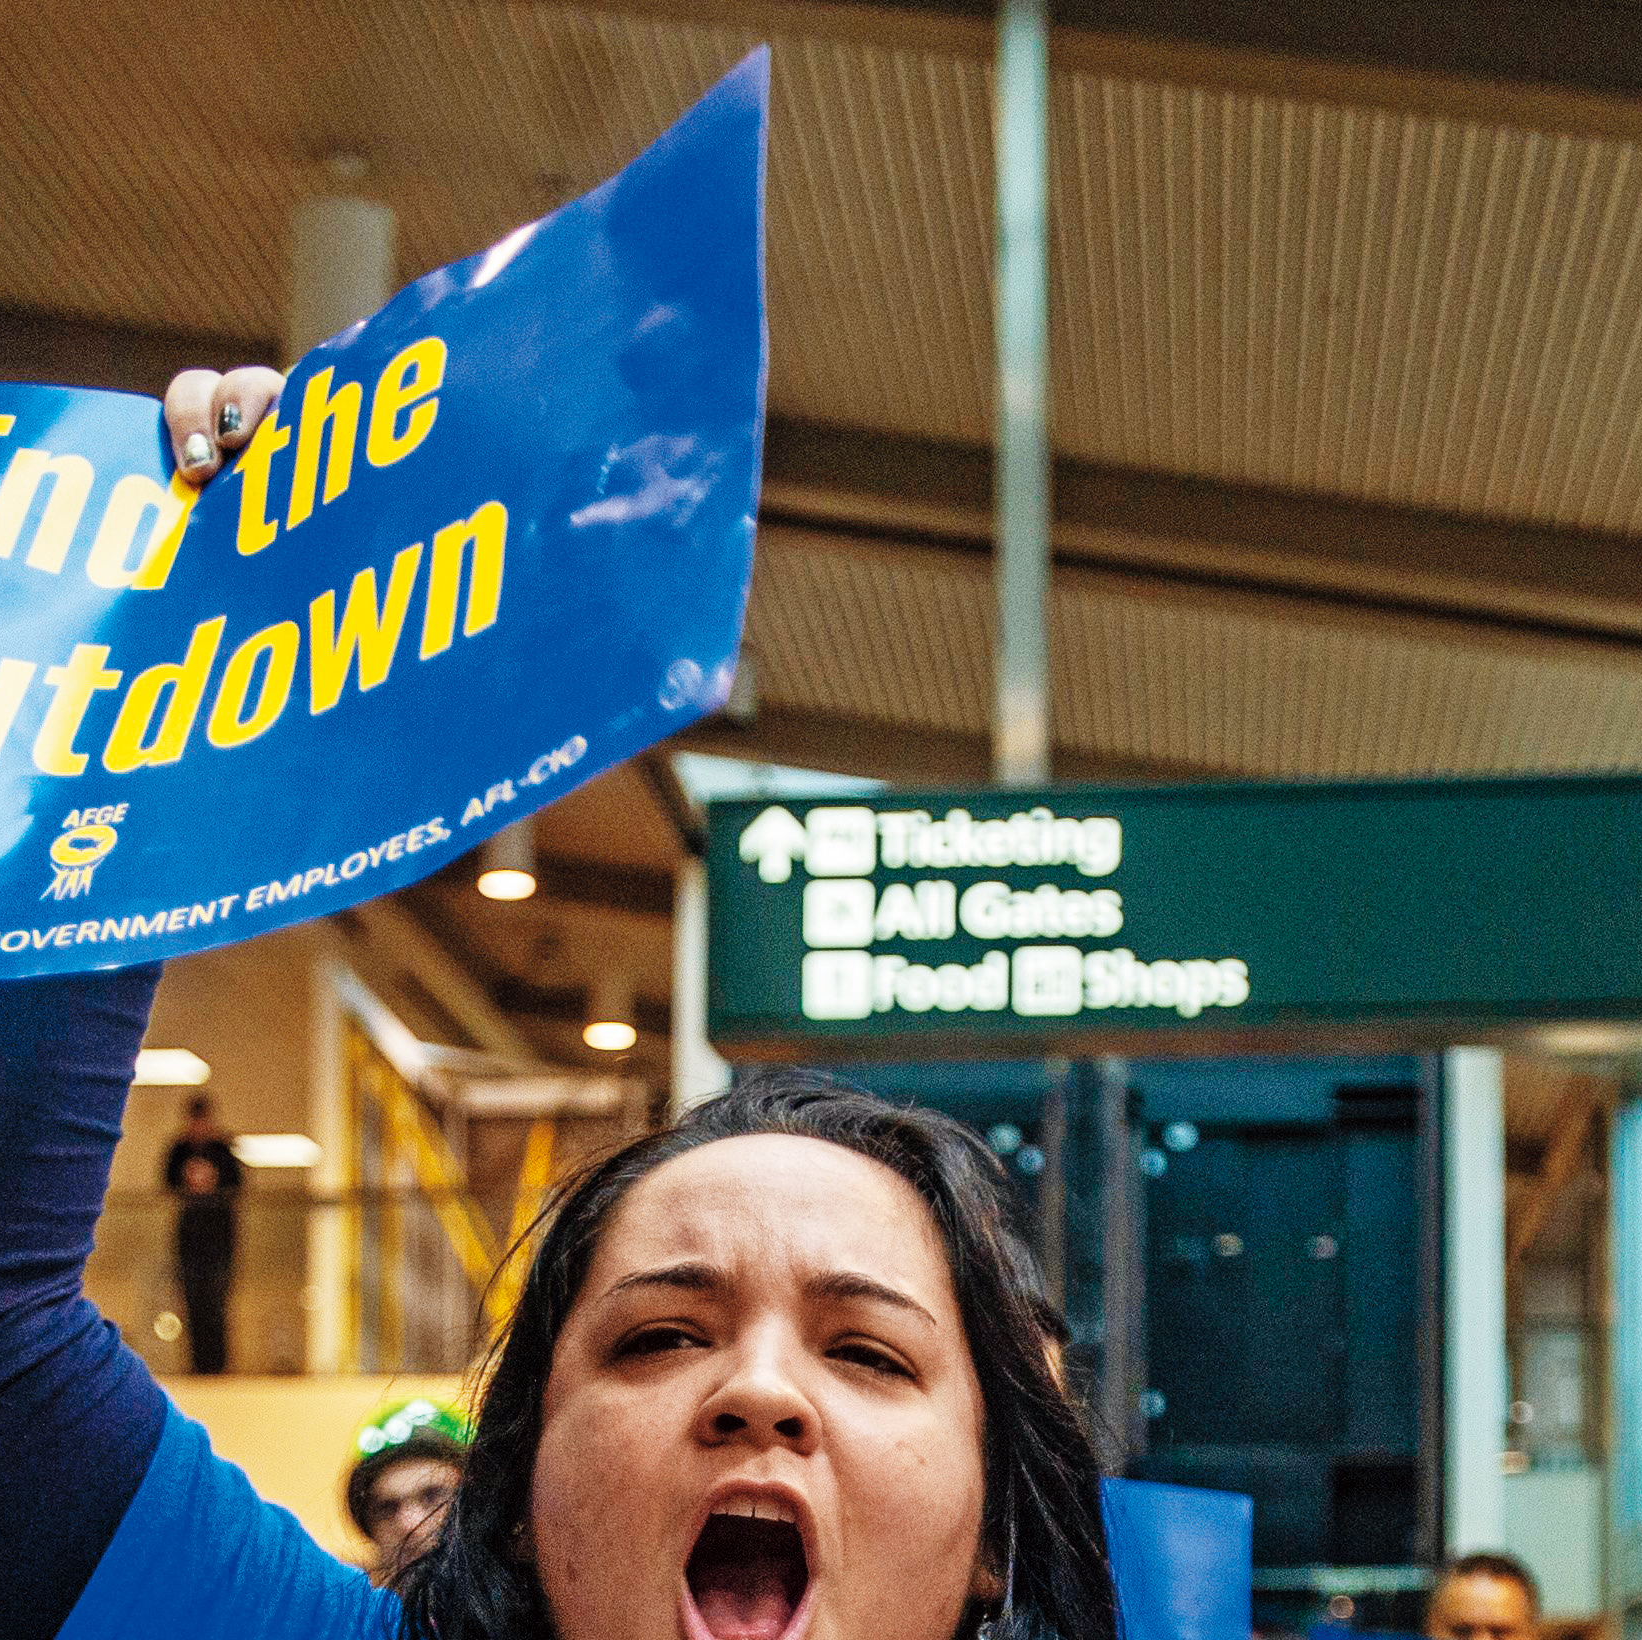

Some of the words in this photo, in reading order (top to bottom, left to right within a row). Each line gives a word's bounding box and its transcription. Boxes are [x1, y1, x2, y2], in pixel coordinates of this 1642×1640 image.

[234, 336, 448, 556] the
[62, 802, 130, 828] AFGE
[244, 816, 452, 913] EMPLOYEES,
[461, 735, 588, 826] AFL-CIO
[878, 807, 1123, 877] Ticketing
[874, 879, 957, 941] All
[959, 881, 1124, 940] Gates
[873, 949, 1011, 1012] Food
[1082, 947, 1250, 1018] Shops
